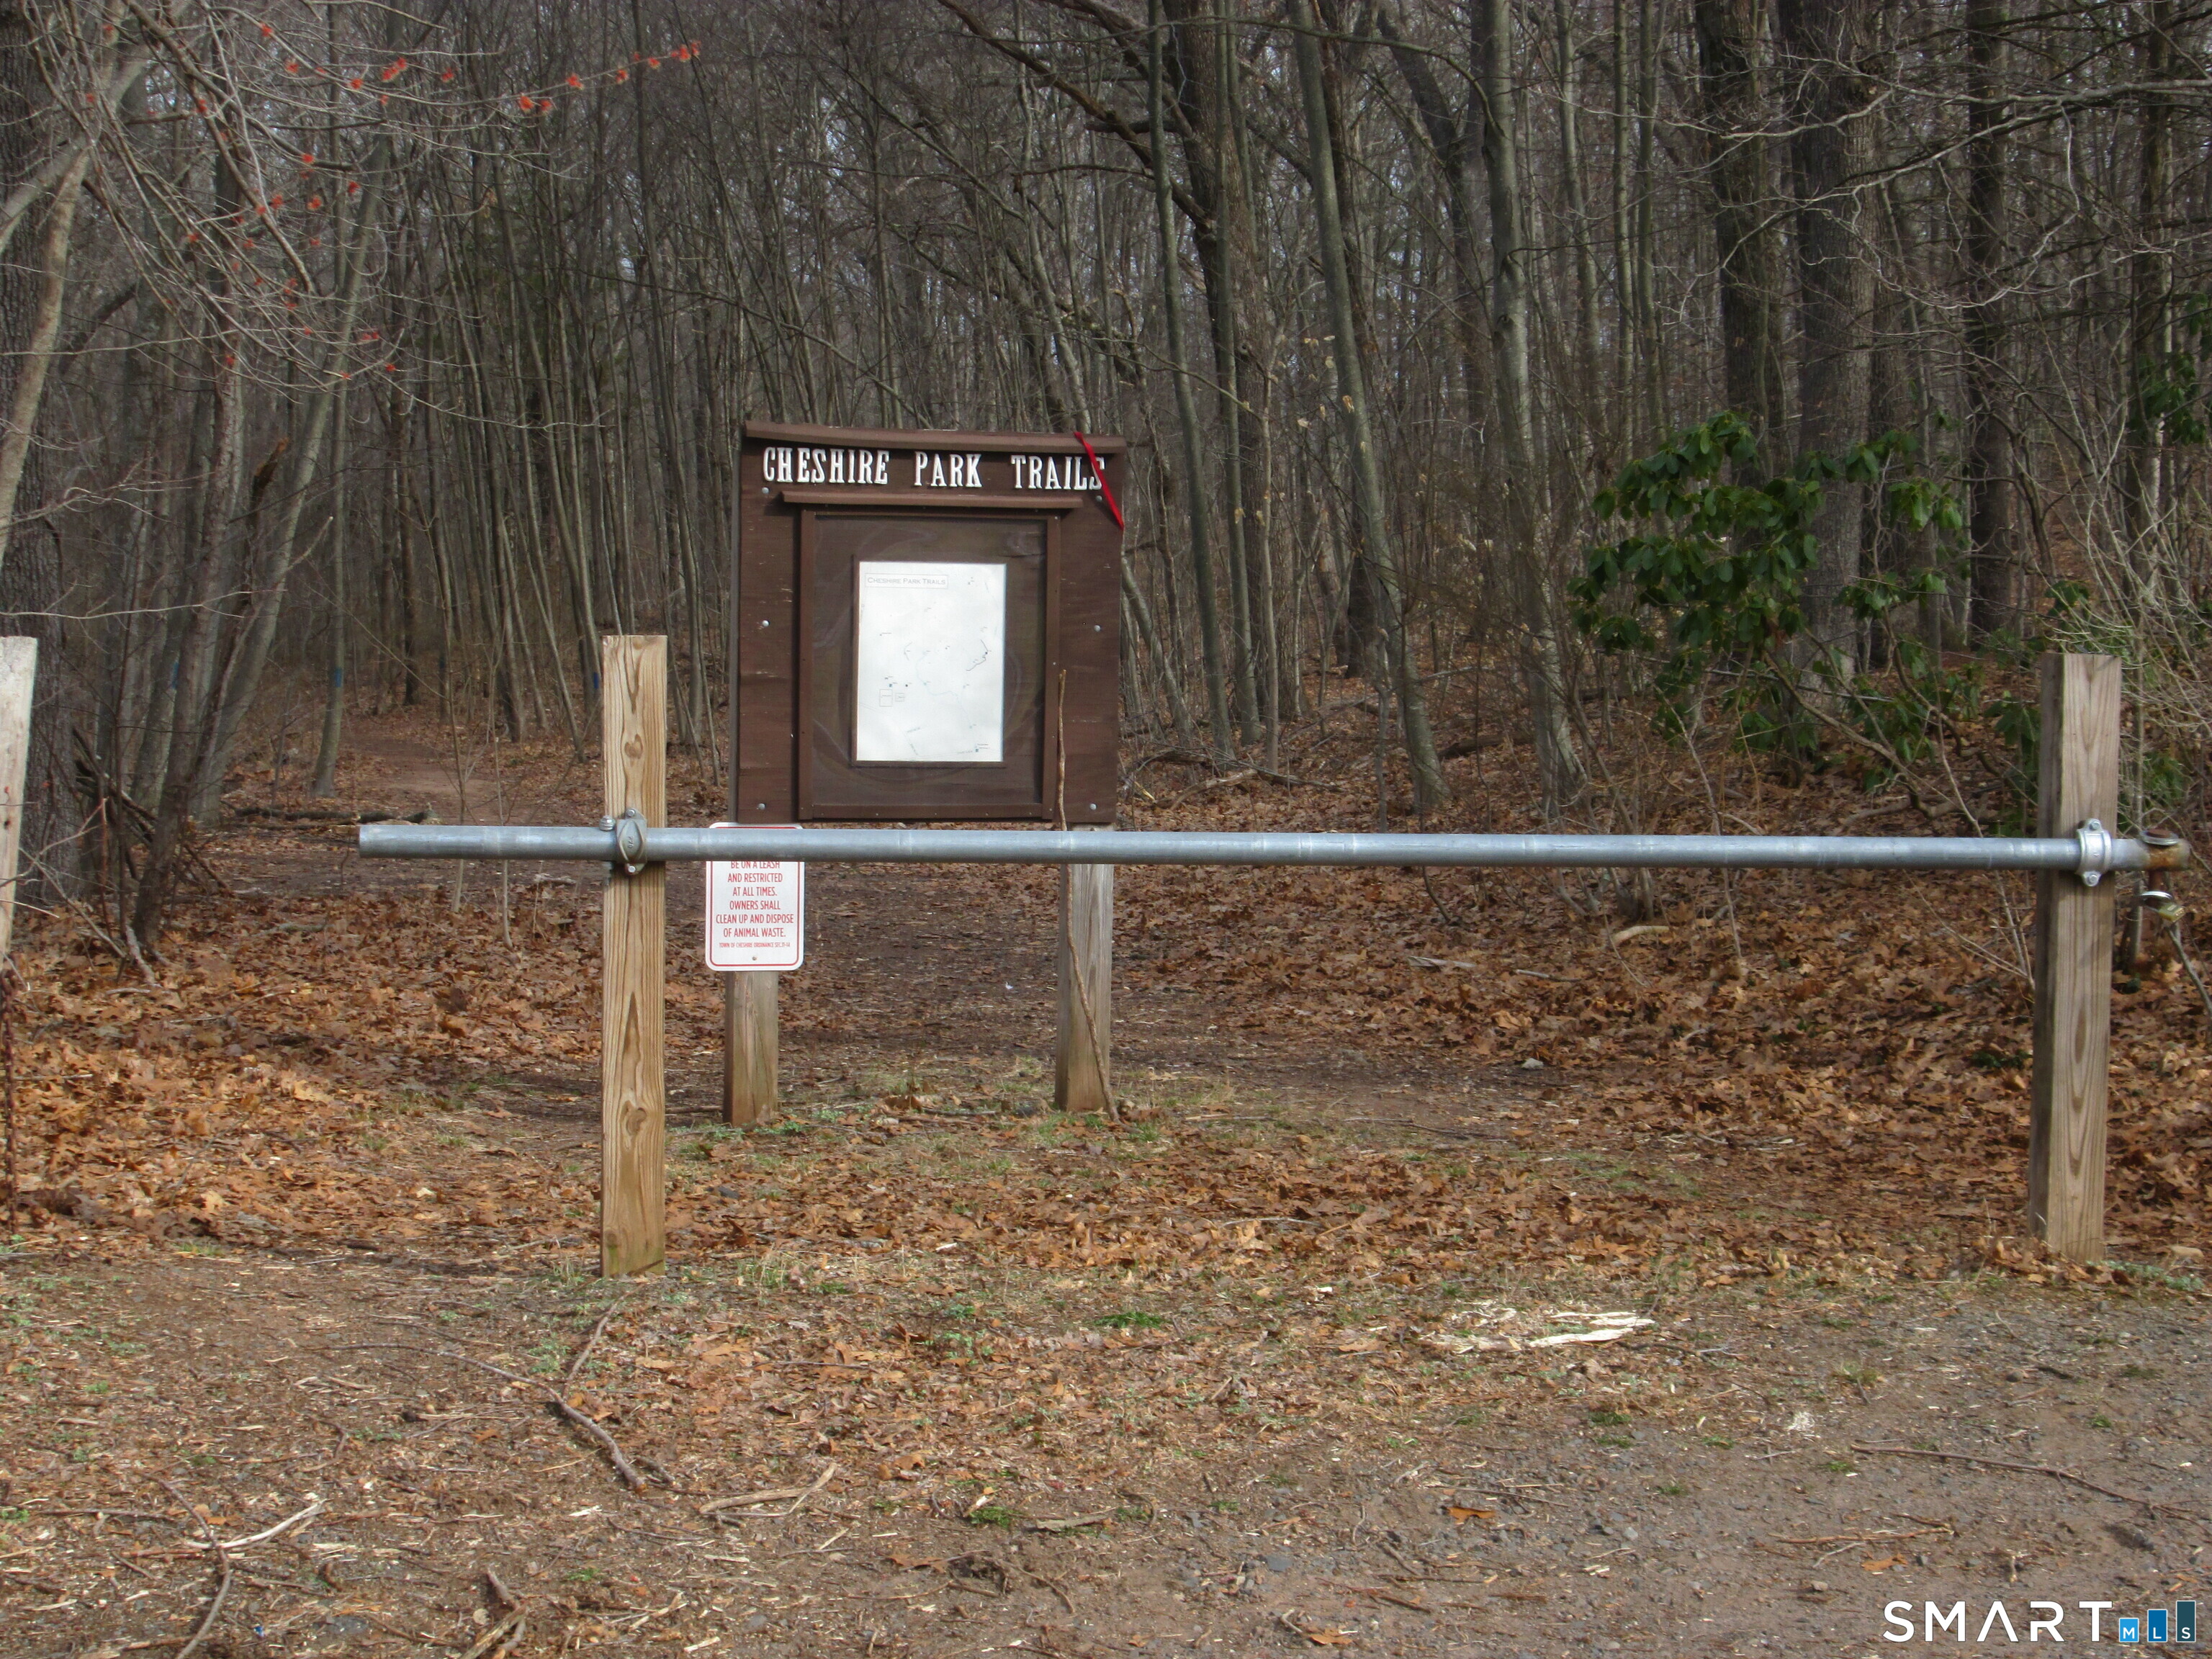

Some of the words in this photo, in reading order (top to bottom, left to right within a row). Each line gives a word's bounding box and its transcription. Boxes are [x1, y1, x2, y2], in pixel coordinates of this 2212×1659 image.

[762, 446, 890, 485] CHESHIRE
[913, 452, 983, 487] PARK
[1010, 455, 1106, 490] TRAILS
[727, 873, 742, 882] AND
[745, 873, 783, 882] RESTRICTED
[732, 886, 741, 896] AT
[742, 886, 754, 896] ALL
[756, 886, 778, 896] TIMES.
[729, 900, 758, 909] OWNERS
[760, 900, 781, 909] SHALL
[716, 914, 737, 923] CLEAN
[739, 914, 748, 923] UP
[750, 914, 764, 923] AND
[766, 914, 794, 923] DISPOSE
[723, 927, 732, 937] OF
[734, 927, 760, 937] ANIMAL
[761, 927, 786, 937] WASTE.
